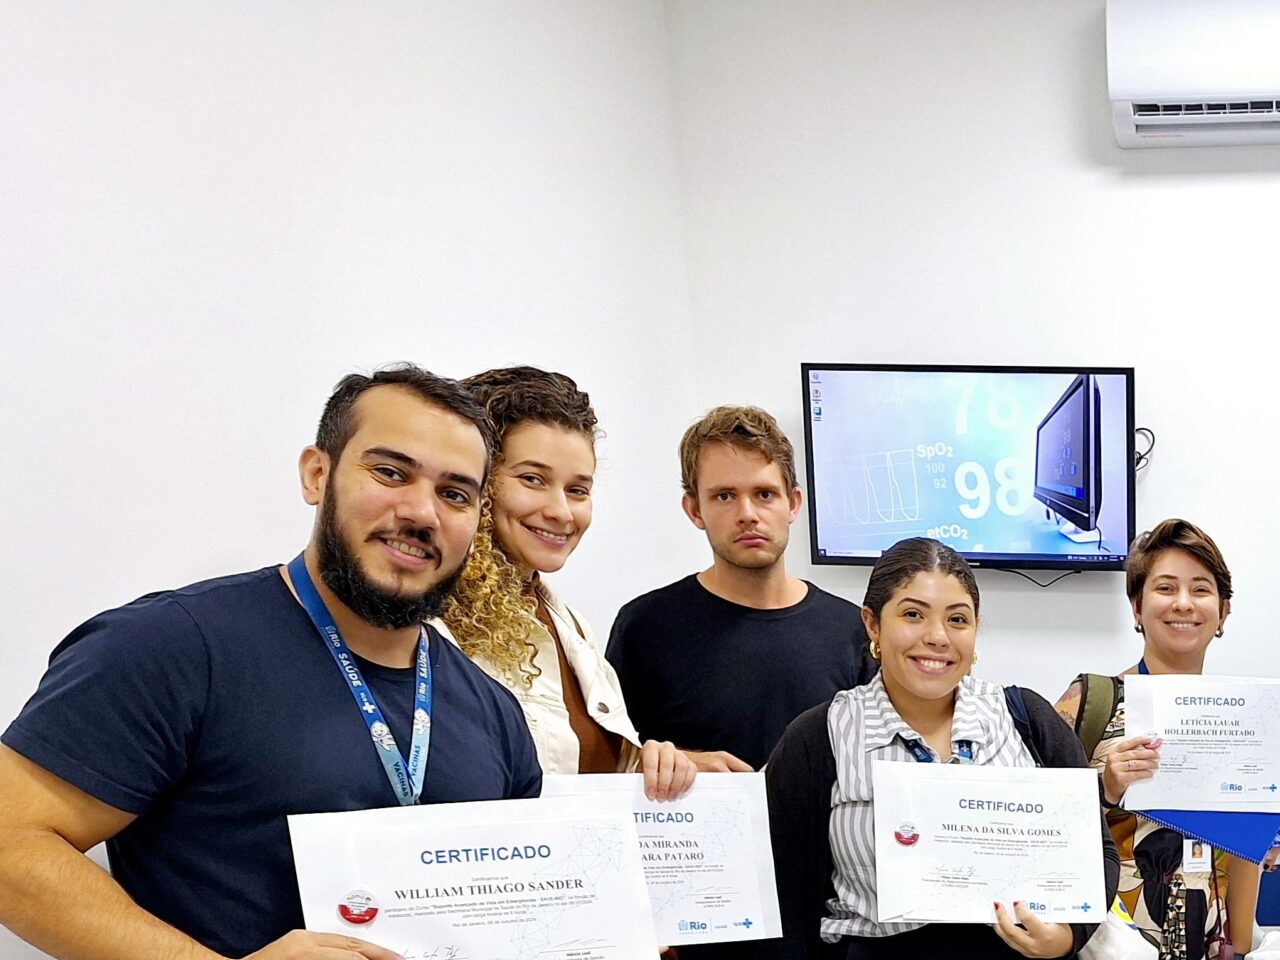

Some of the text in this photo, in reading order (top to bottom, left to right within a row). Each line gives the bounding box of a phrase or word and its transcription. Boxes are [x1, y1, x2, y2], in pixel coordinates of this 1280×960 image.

[926, 462, 945, 474] 100
[933, 478, 947, 489] 92
[954, 458, 1032, 519] 98
[329, 632, 362, 688] Rio SAÚDE
[418, 648, 428, 679] SAÚDE
[1174, 696, 1246, 707] CERTIFICADO
[1180, 718, 1213, 727] LETÍCIA
[1164, 728, 1256, 737] HOLLERBACH FURTADO
[410, 745, 421, 778] VACINAS
[393, 761, 408, 798] VACINAS
[958, 798, 1044, 814] CERTIFICADO
[633, 812, 694, 824] TIFICADO
[942, 823, 980, 834] MILENA
[982, 826, 996, 835] DA
[997, 826, 1025, 836] SILVA
[1027, 828, 1062, 837] GOMES
[652, 840, 698, 849] MIRANDA
[420, 844, 552, 866] CERTIFICADO
[665, 852, 704, 861] PATARO
[394, 879, 584, 900] WILLIAM THIAGO SANDER
[1029, 902, 1046, 911] Rio
[689, 921, 708, 931] Rio
